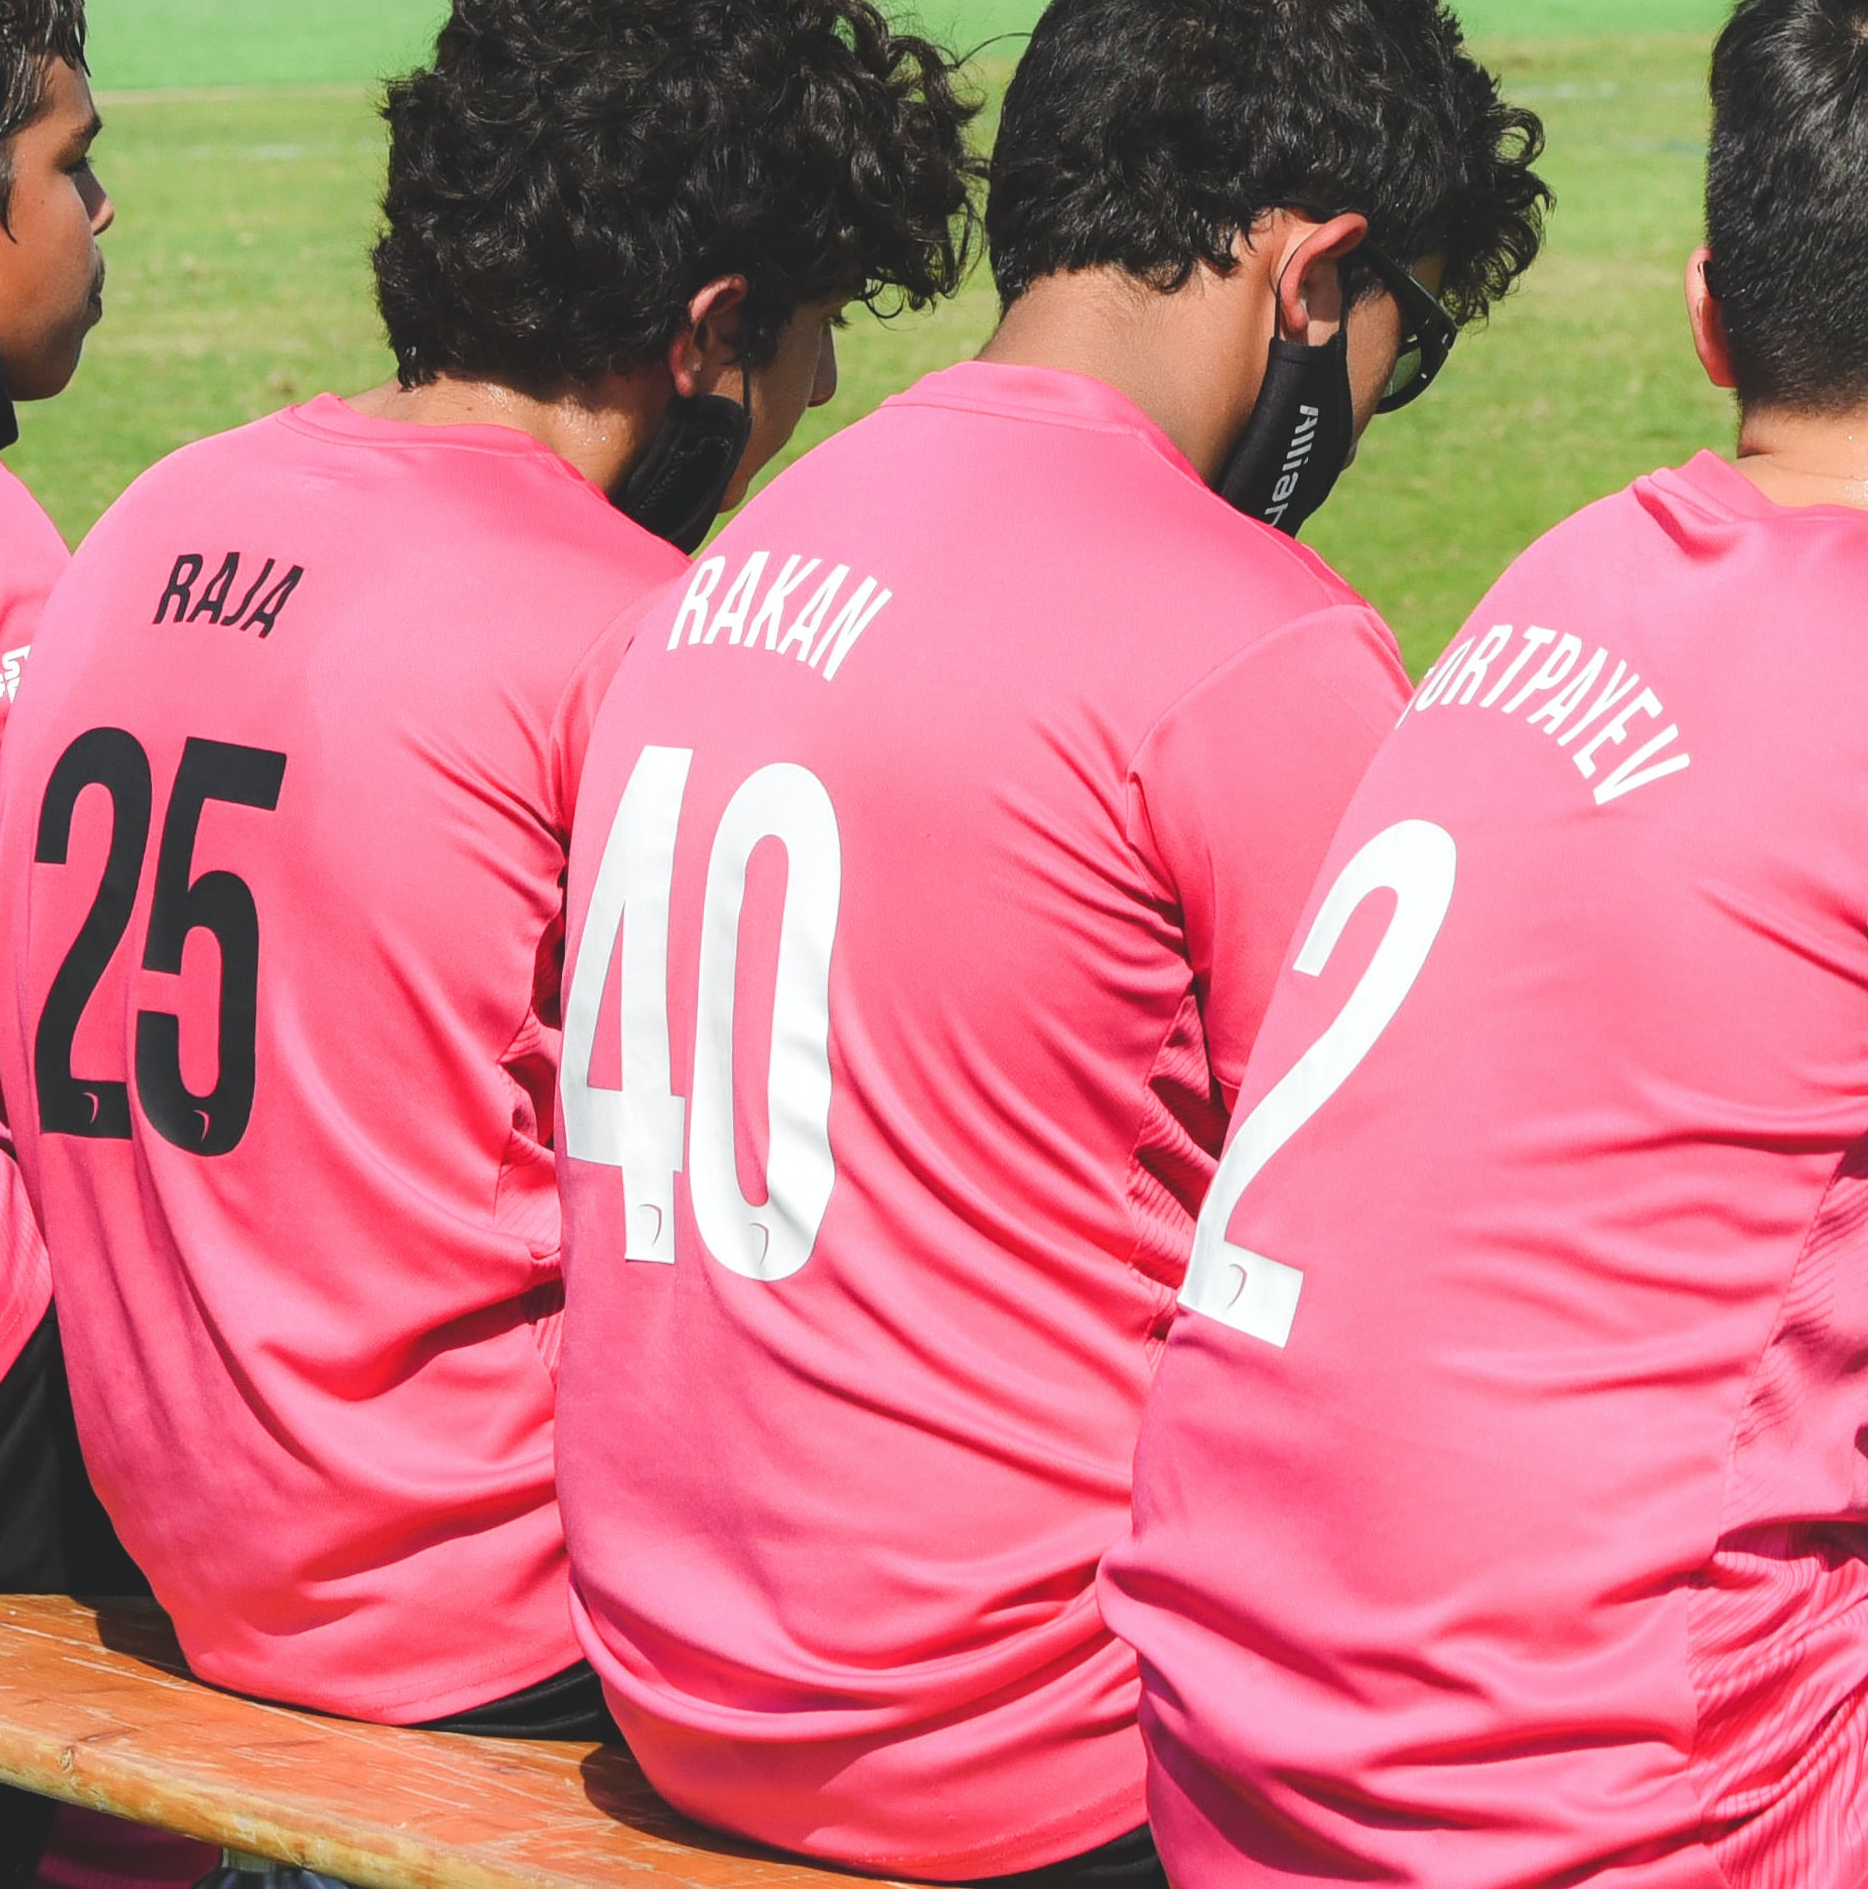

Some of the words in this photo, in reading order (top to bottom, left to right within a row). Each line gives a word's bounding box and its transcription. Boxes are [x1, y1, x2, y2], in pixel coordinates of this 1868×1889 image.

[152, 551, 305, 640] RAJA
[666, 551, 892, 682] RAKAN
[1394, 624, 1692, 806] ORTPAYEV
[33, 726, 288, 1158] 25
[559, 745, 843, 1283] 40
[1176, 818, 1458, 1349] 2
